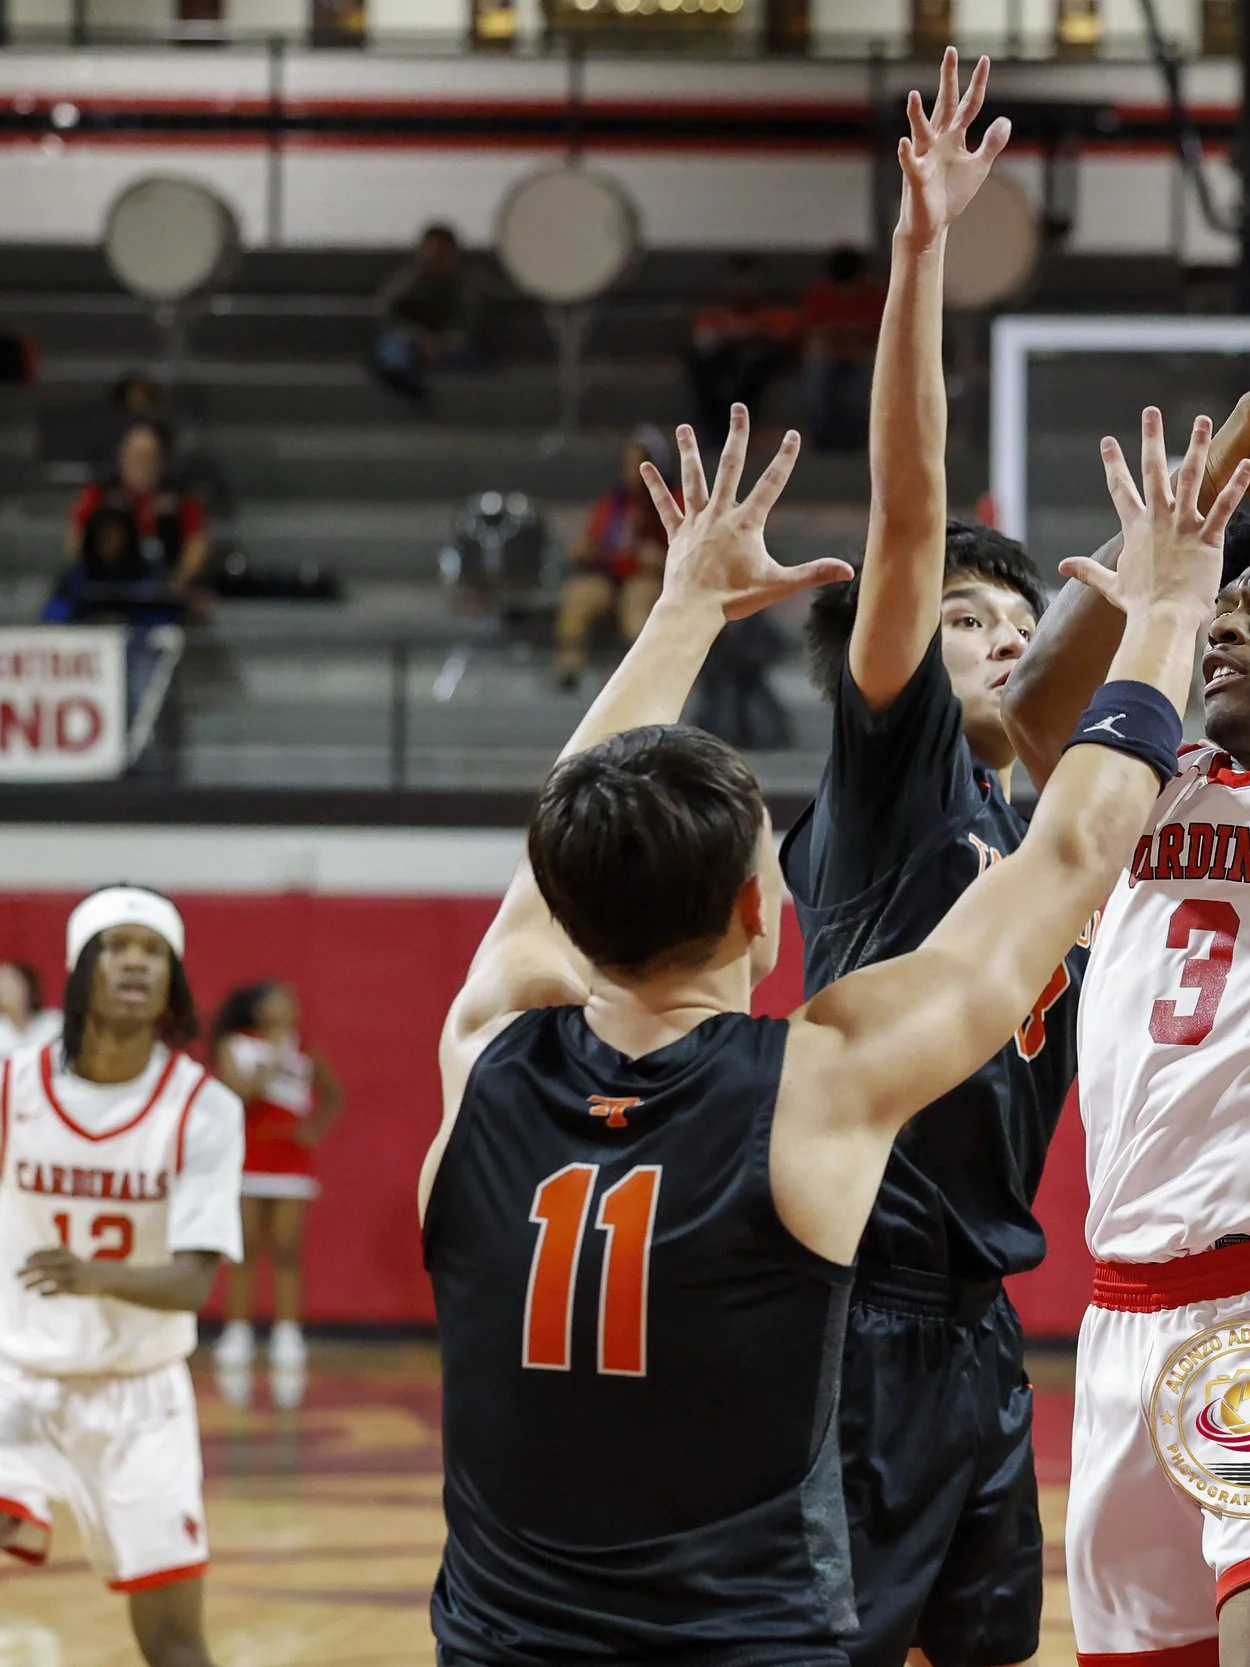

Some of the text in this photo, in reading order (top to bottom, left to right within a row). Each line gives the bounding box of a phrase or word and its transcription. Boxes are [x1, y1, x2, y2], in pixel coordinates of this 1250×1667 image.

[1148, 898, 1241, 1046] 3
[16, 1160, 171, 1203] CARDINALS
[522, 1162, 663, 1377] 11
